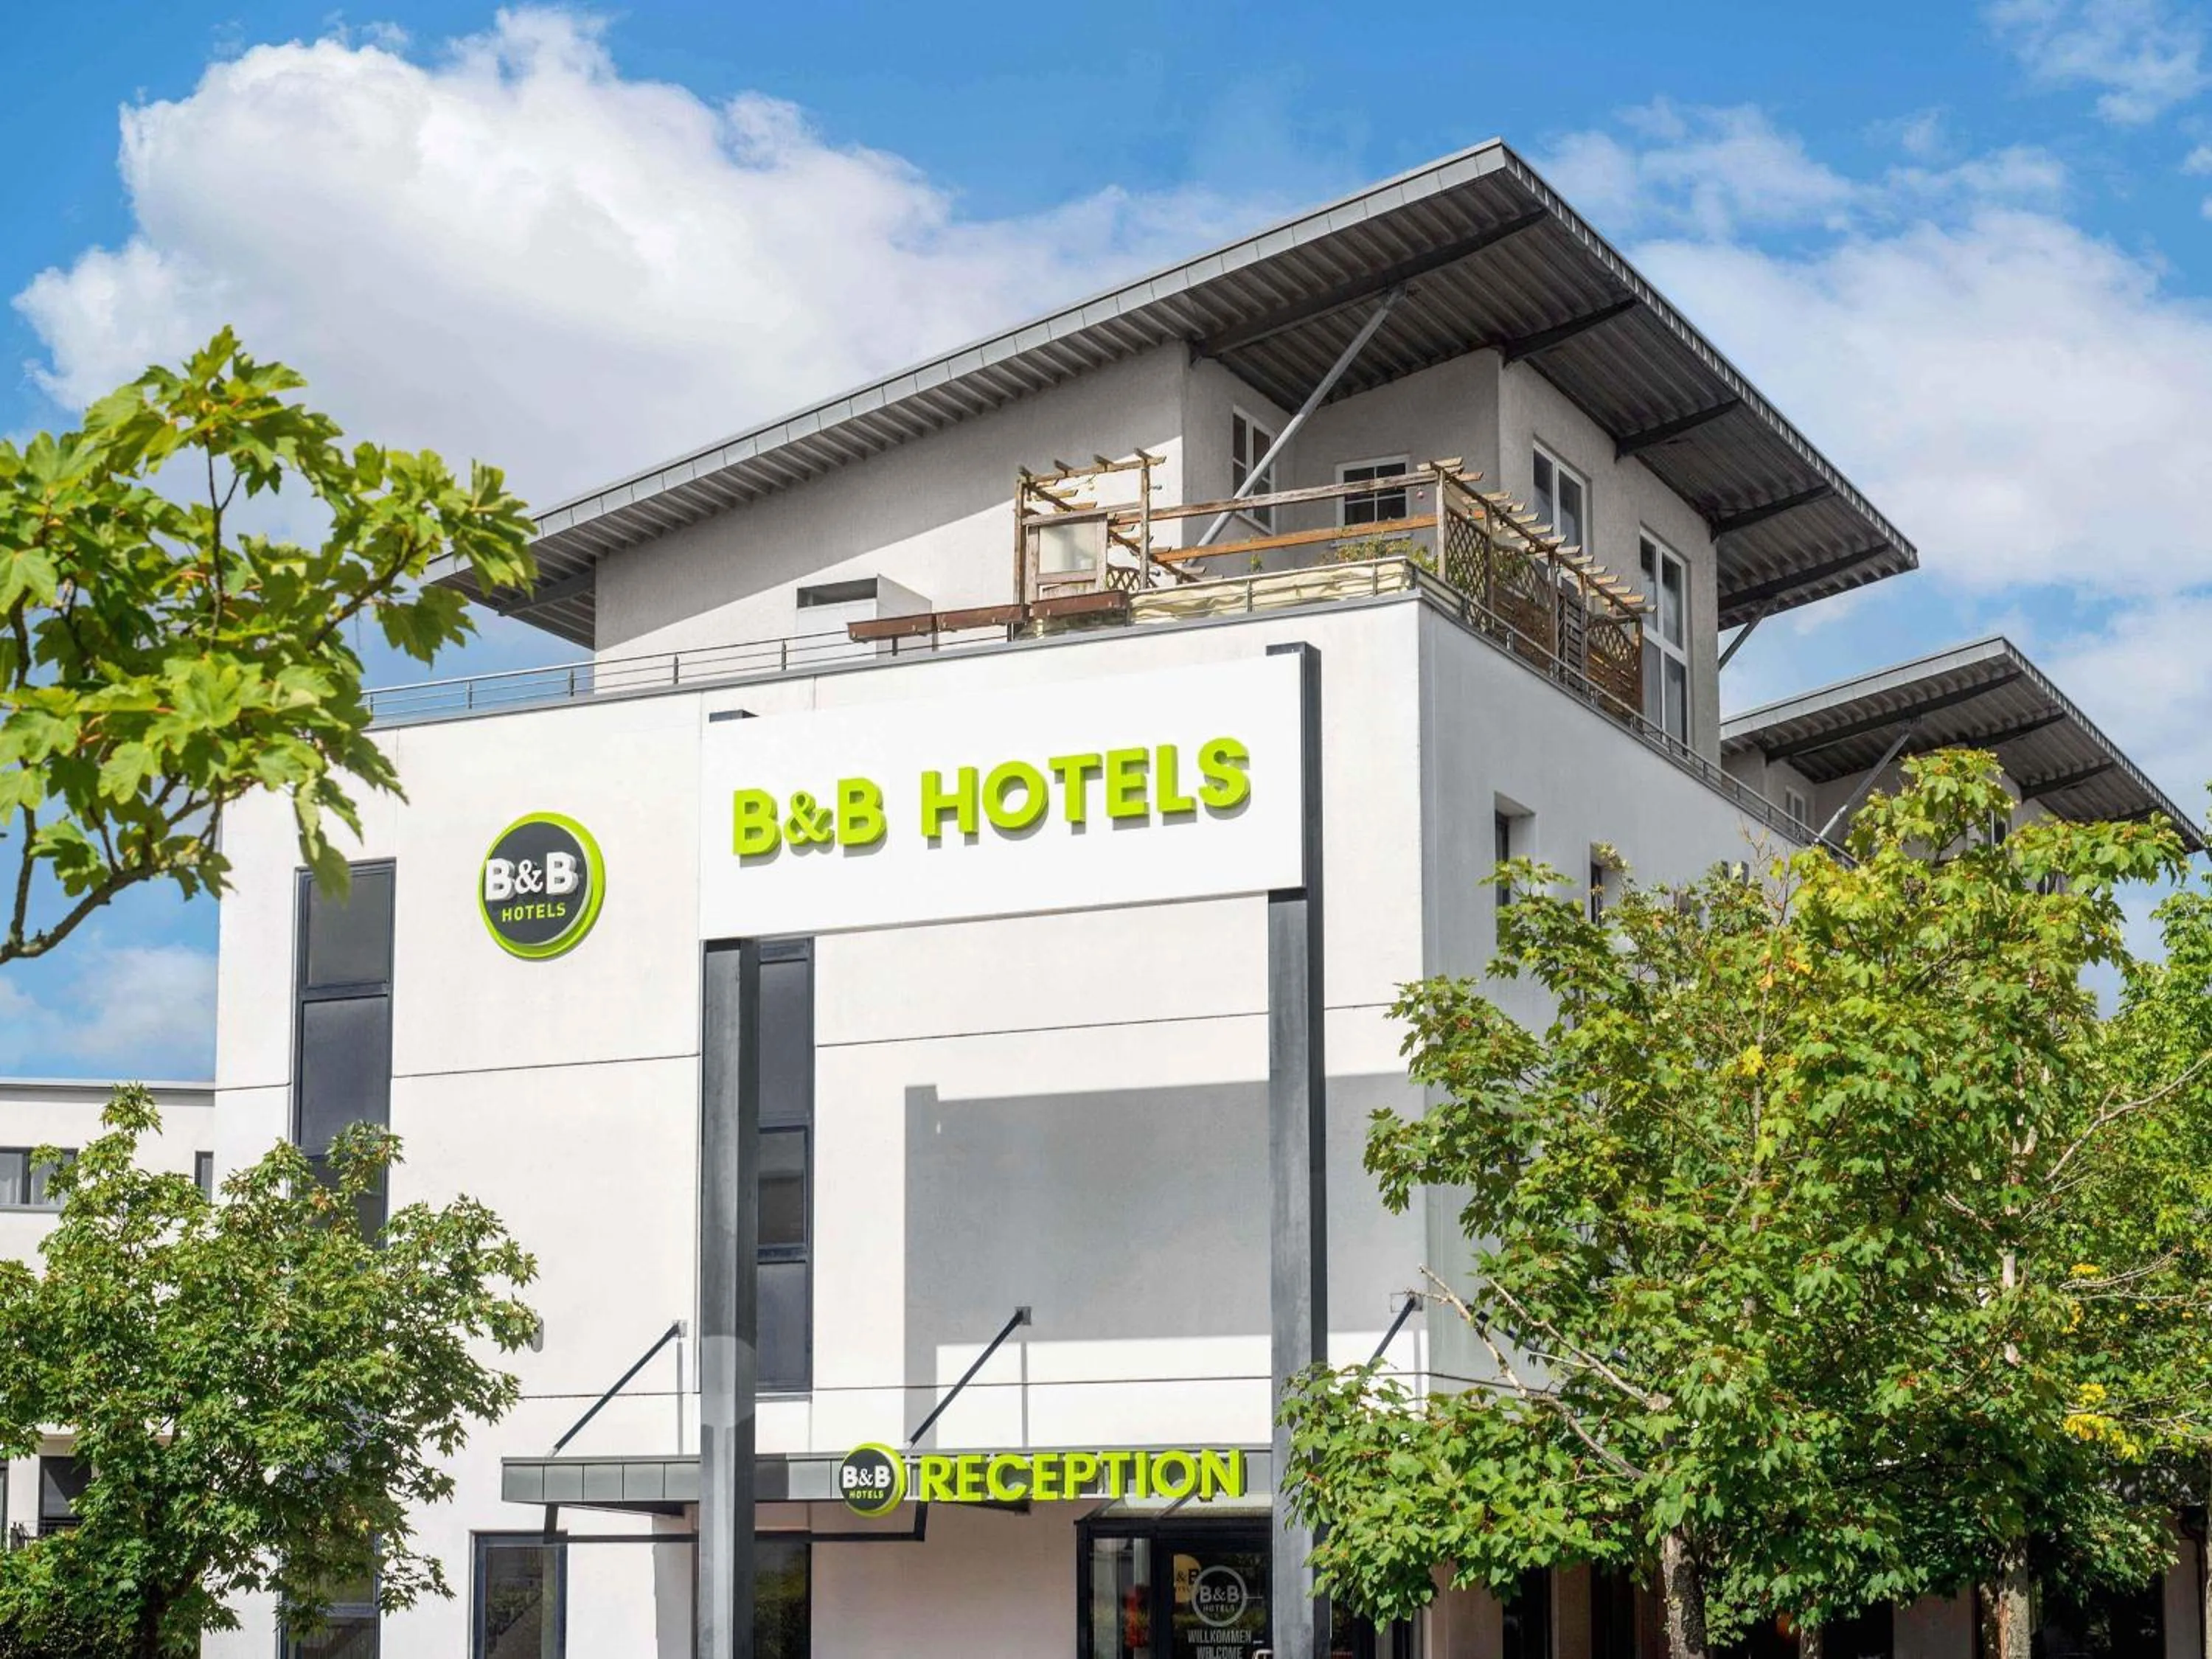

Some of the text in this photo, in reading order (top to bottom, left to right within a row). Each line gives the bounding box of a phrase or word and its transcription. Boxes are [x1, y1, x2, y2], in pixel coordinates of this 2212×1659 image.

[733, 737, 1251, 857] B&B HOTELS
[485, 852, 579, 901] B&B
[502, 902, 566, 922] HOTELS
[843, 1465, 891, 1488] B&B
[918, 1449, 1245, 1502] RECEPTION
[849, 1490, 884, 1499] HOTELS
[1200, 1585, 1239, 1603] B&B
[1187, 1628, 1251, 1644] WILLKOMMEN
